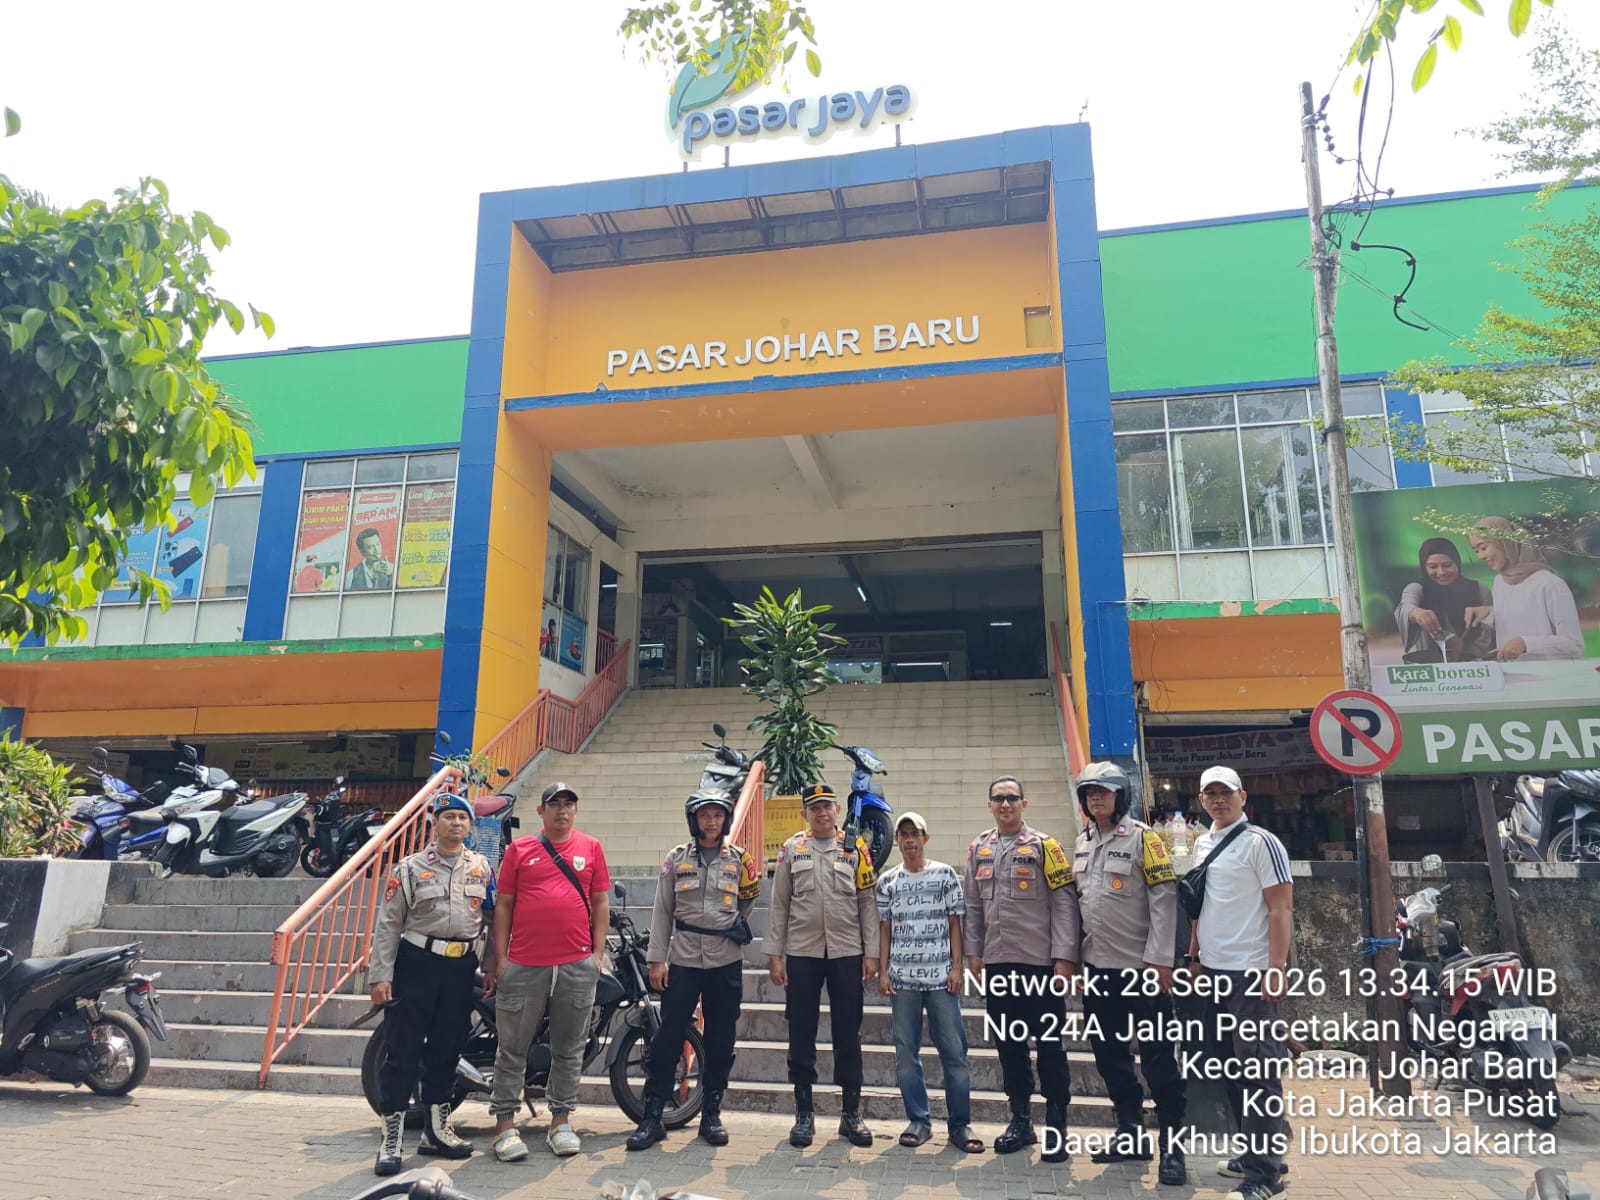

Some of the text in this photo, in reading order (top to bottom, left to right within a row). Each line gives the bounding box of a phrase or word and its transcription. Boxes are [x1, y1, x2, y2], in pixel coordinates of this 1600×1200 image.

[683, 84, 912, 154] pasar jaya
[606, 315, 981, 376] PASAR JOHAR BARU
[1392, 665, 1490, 683] kara borasi
[1218, 751, 1243, 762] Johar
[1013, 856, 1037, 865] POLRI
[1107, 850, 1132, 860] POLRI
[895, 881, 924, 894] LEVIS
[910, 967, 940, 979] LEVIS
